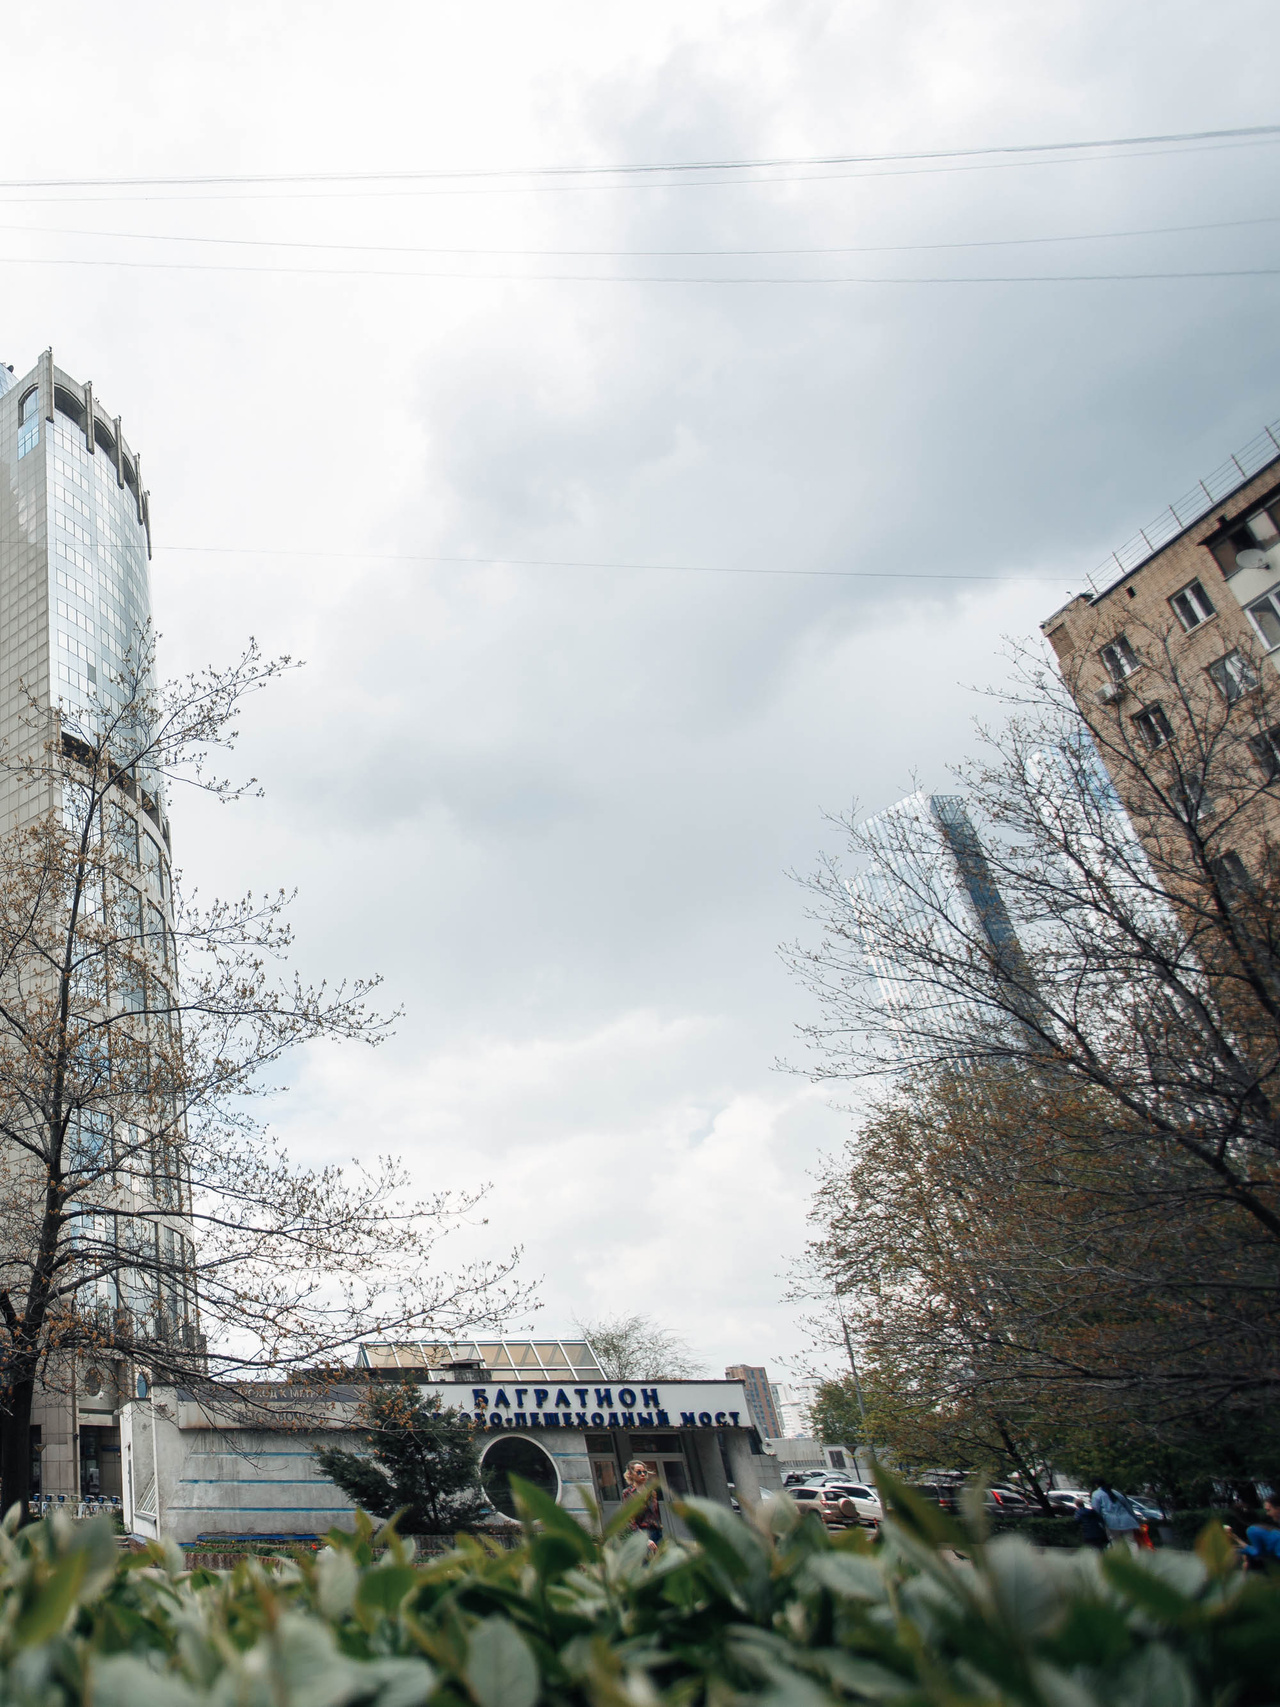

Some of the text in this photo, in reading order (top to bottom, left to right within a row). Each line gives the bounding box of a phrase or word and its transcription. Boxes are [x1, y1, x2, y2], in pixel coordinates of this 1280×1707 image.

[290, 1388, 324, 1398] МЕТР
[472, 1388, 660, 1409] БАГРАТИОН
[680, 1411, 740, 1427] МОСТ
